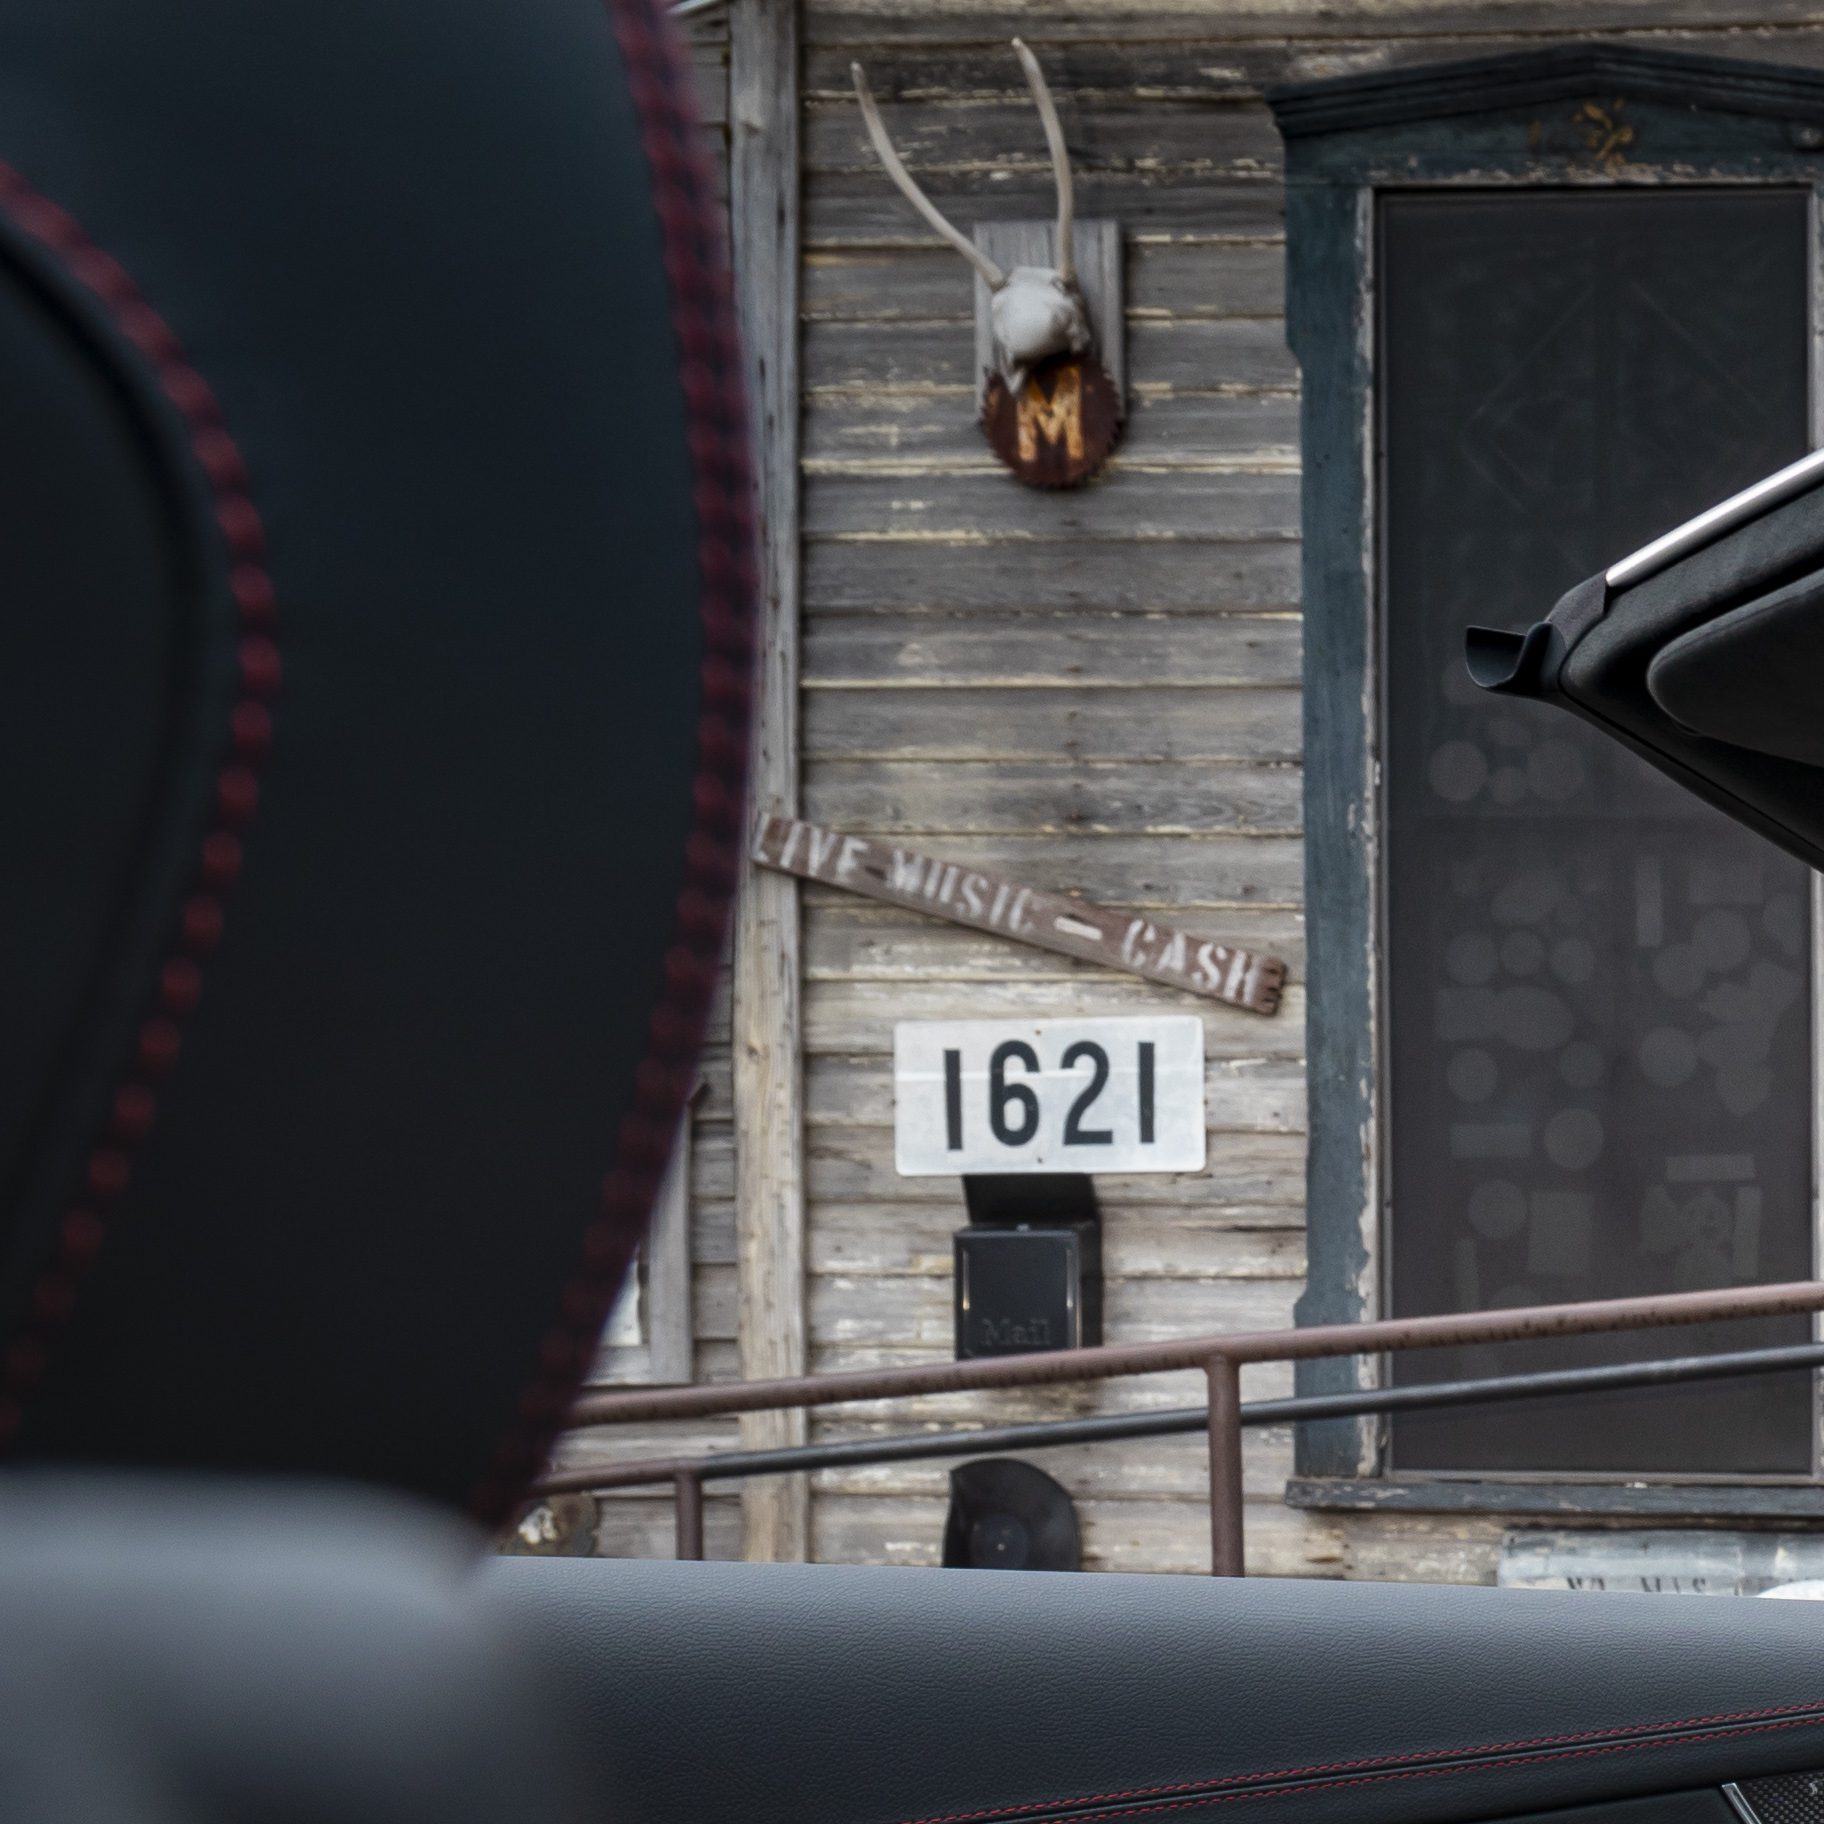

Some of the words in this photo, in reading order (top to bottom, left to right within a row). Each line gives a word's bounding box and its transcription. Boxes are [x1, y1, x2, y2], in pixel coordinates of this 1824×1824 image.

[1016, 365, 1085, 463] M
[752, 811, 868, 885] LIVE
[890, 849, 1036, 933] MUSIC
[1123, 918, 1262, 1001] CASH
[943, 1039, 1156, 1152] 1621
